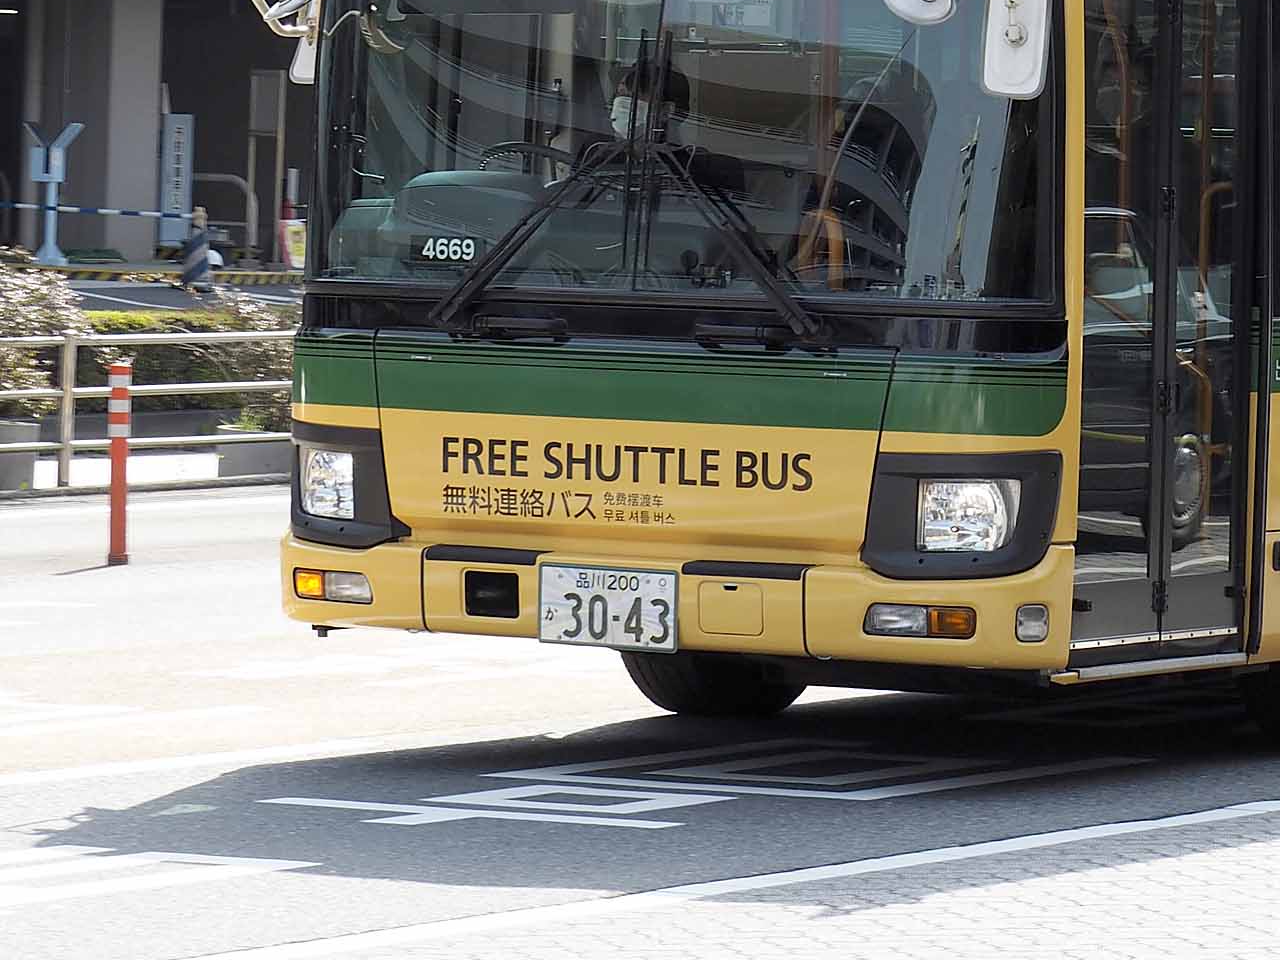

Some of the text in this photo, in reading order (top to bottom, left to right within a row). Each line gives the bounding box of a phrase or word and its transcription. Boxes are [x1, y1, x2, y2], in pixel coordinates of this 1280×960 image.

[421, 236, 476, 261] 4669
[441, 436, 813, 492] FREE SHUTTLE BUS
[442, 484, 597, 520] 無料連絡バス
[602, 509, 676, 525] 무료 셔틀 버스
[544, 607, 558, 621] か
